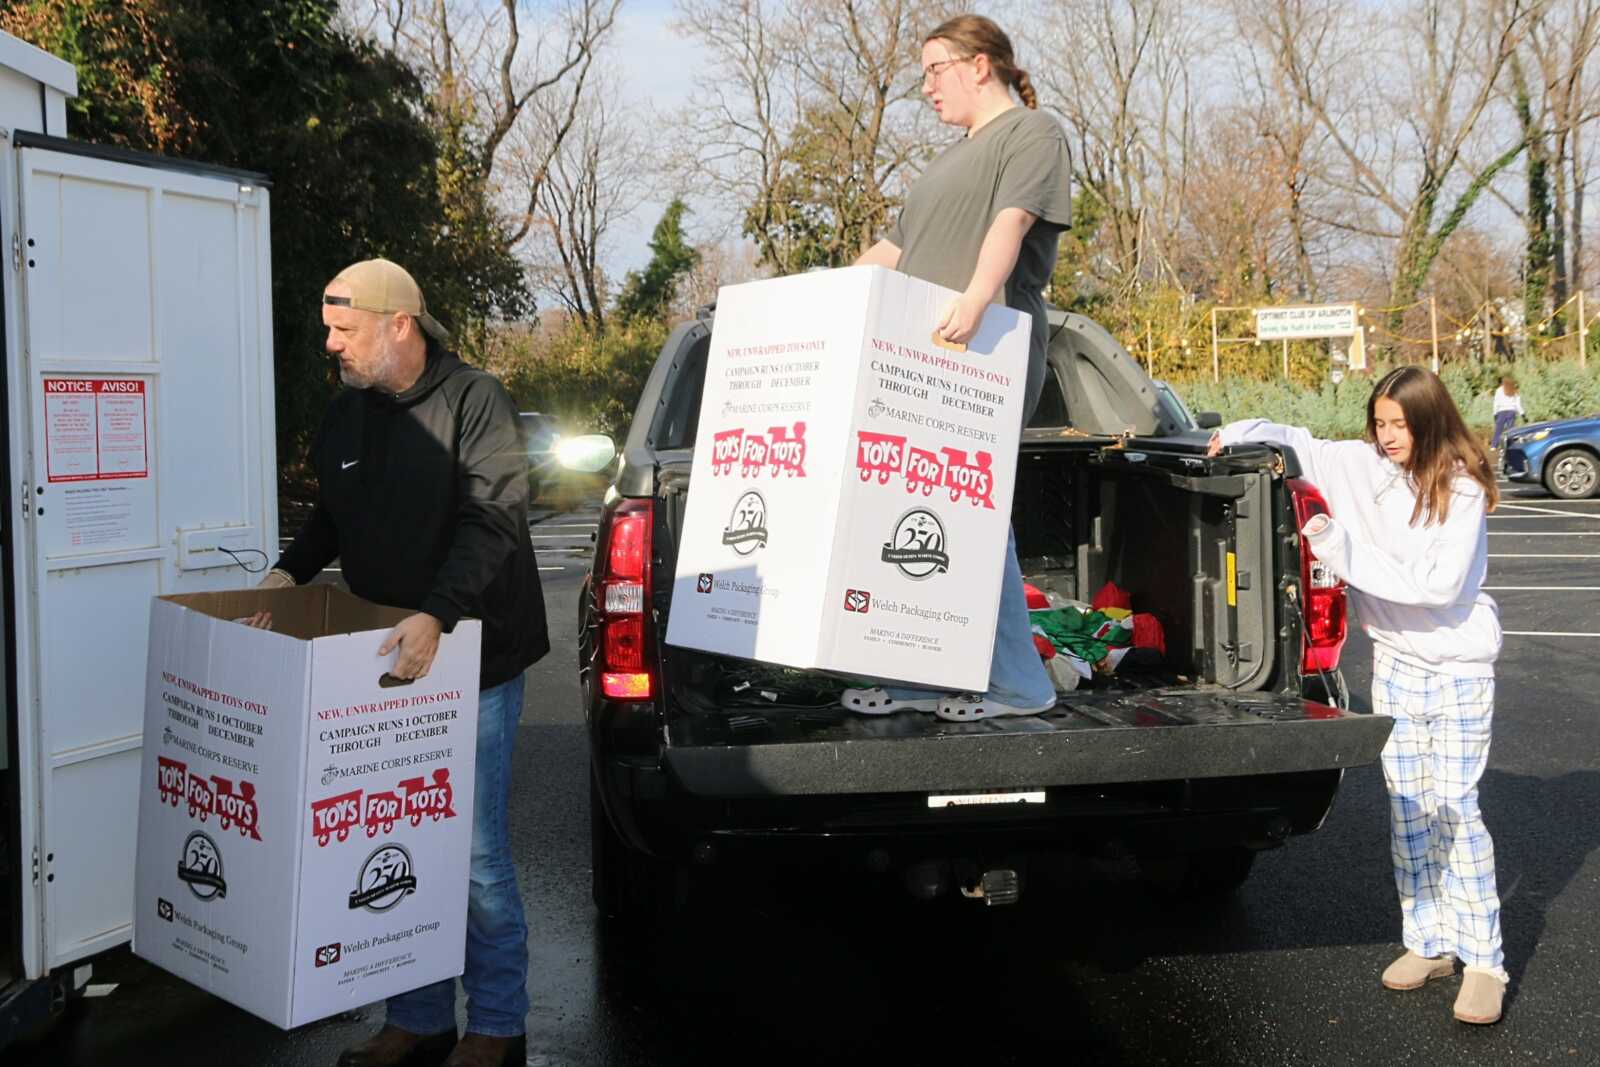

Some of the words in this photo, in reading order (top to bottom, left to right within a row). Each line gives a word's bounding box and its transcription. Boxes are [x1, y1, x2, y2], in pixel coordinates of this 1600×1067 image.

[1289, 310, 1306, 319] CLUB
[1308, 309, 1316, 318] OF
[1318, 308, 1351, 318] ARLINGTON
[805, 340, 826, 351] ONLY
[725, 366, 760, 376] CAMPAIGN
[785, 361, 820, 372] OCTOBER
[871, 338, 896, 355] NEW,
[898, 346, 959, 372] UNWRAPPED
[961, 366, 984, 380] TOYS
[986, 372, 1011, 387] ONLY
[48, 382, 92, 391] NOTICE
[101, 382, 139, 391] AVISO!
[729, 380, 762, 390] THROUGH
[771, 376, 811, 388] DECEMBER
[870, 360, 924, 384] CAMPAIGN
[926, 376, 950, 392] RUNS
[953, 382, 958, 393] 1
[959, 385, 1004, 406] OCTOBER
[878, 378, 928, 400] THROUGH
[942, 395, 994, 418] DECEMBER
[886, 406, 924, 426] MARINE
[926, 416, 955, 433] CORPS
[957, 425, 997, 444] RESERVE
[715, 436, 740, 460] TOYS
[745, 439, 765, 460] FOR
[772, 442, 802, 466] TOTS
[860, 440, 900, 468] TOYS
[908, 452, 939, 481] FOR
[948, 465, 988, 495] TOTS
[737, 510, 763, 530] 250
[902, 528, 941, 550] 250
[872, 598, 898, 612] Welch
[900, 603, 942, 621] Packaging
[943, 611, 969, 627] Group
[178, 678, 220, 702] UNWRAPPED
[221, 694, 243, 709] TOYS
[244, 700, 268, 716] ONLY
[317, 708, 344, 721] NEW,
[346, 698, 408, 716] UNWRAPPED
[410, 694, 435, 706] TOYS
[436, 689, 463, 703] ONLY
[162, 691, 196, 714] CAMPAIGN
[197, 705, 215, 721] RUNS
[222, 713, 264, 736] OCTOBER
[168, 708, 199, 730] THROUGH
[208, 725, 255, 748] DECEMBER
[320, 723, 375, 742] CAMPAIGN
[377, 720, 403, 732] RUNS
[406, 717, 410, 727] 1
[412, 710, 457, 726] OCTOBER
[174, 735, 197, 755] MARINE
[198, 746, 222, 763] CORPS
[222, 755, 259, 774] RESERVE
[330, 738, 381, 755] THROUGH
[395, 725, 448, 743] DECEMBER
[340, 762, 380, 778] MARINE
[381, 757, 412, 770] CORPS
[413, 748, 453, 764] RESERVE
[160, 766, 184, 790] TOYS
[189, 780, 210, 806] FOR
[218, 794, 253, 825] TOTS
[315, 798, 358, 829] TOYS
[367, 798, 398, 819] FOR
[408, 788, 447, 809] TOTS
[190, 849, 219, 876] 250
[370, 861, 406, 889] 250
[343, 940, 370, 954] Welch
[372, 930, 414, 947] Packaging
[415, 921, 440, 934] Group
